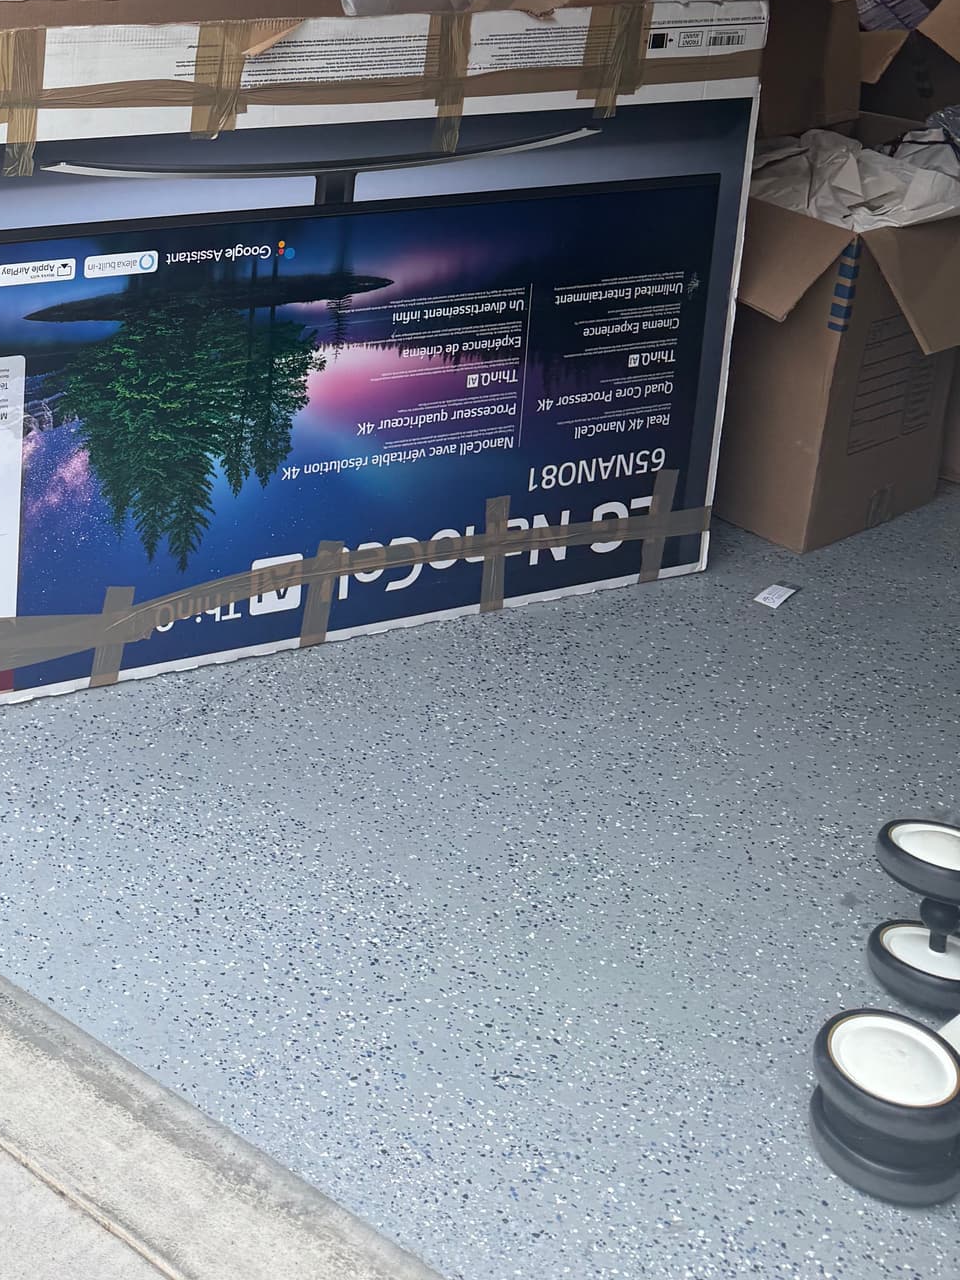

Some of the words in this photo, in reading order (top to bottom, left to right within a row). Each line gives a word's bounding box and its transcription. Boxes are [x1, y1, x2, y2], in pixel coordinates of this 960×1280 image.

[681, 39, 699, 47] FRONT
[166, 248, 223, 265] Assistant
[225, 244, 272, 260] Google
[0, 266, 30, 276] AirPlay
[32, 264, 55, 274] Apple
[87, 260, 115, 273] built-in
[116, 258, 138, 270] alexa
[554, 286, 632, 306] Entertainment
[634, 282, 683, 297] Unlimited
[423, 300, 506, 322] divertissement
[509, 298, 524, 312] Un
[392, 309, 420, 324] infini
[642, 316, 680, 332] Cinema
[583, 319, 640, 338] Experience
[445, 342, 459, 356] de
[462, 334, 522, 354] Expérience
[402, 345, 443, 360] cinéma
[640, 349, 675, 366] ThinQ
[480, 368, 518, 386] ThinQ
[615, 385, 642, 400] Core
[644, 380, 674, 398] Quad
[536, 398, 554, 412] 4K
[556, 390, 612, 407] Processor
[450, 402, 516, 420] Processeur
[377, 408, 448, 432] quadricœur
[627, 418, 644, 432] 4K
[646, 413, 670, 430] Real
[356, 421, 375, 436] 4K
[574, 419, 626, 439] NanoCell
[429, 443, 457, 456] avec
[458, 435, 514, 456] NanoCell
[302, 454, 369, 476] résolution
[371, 448, 426, 467] véritable
[281, 466, 300, 482] 4K
[528, 448, 666, 492] 65NANO81
